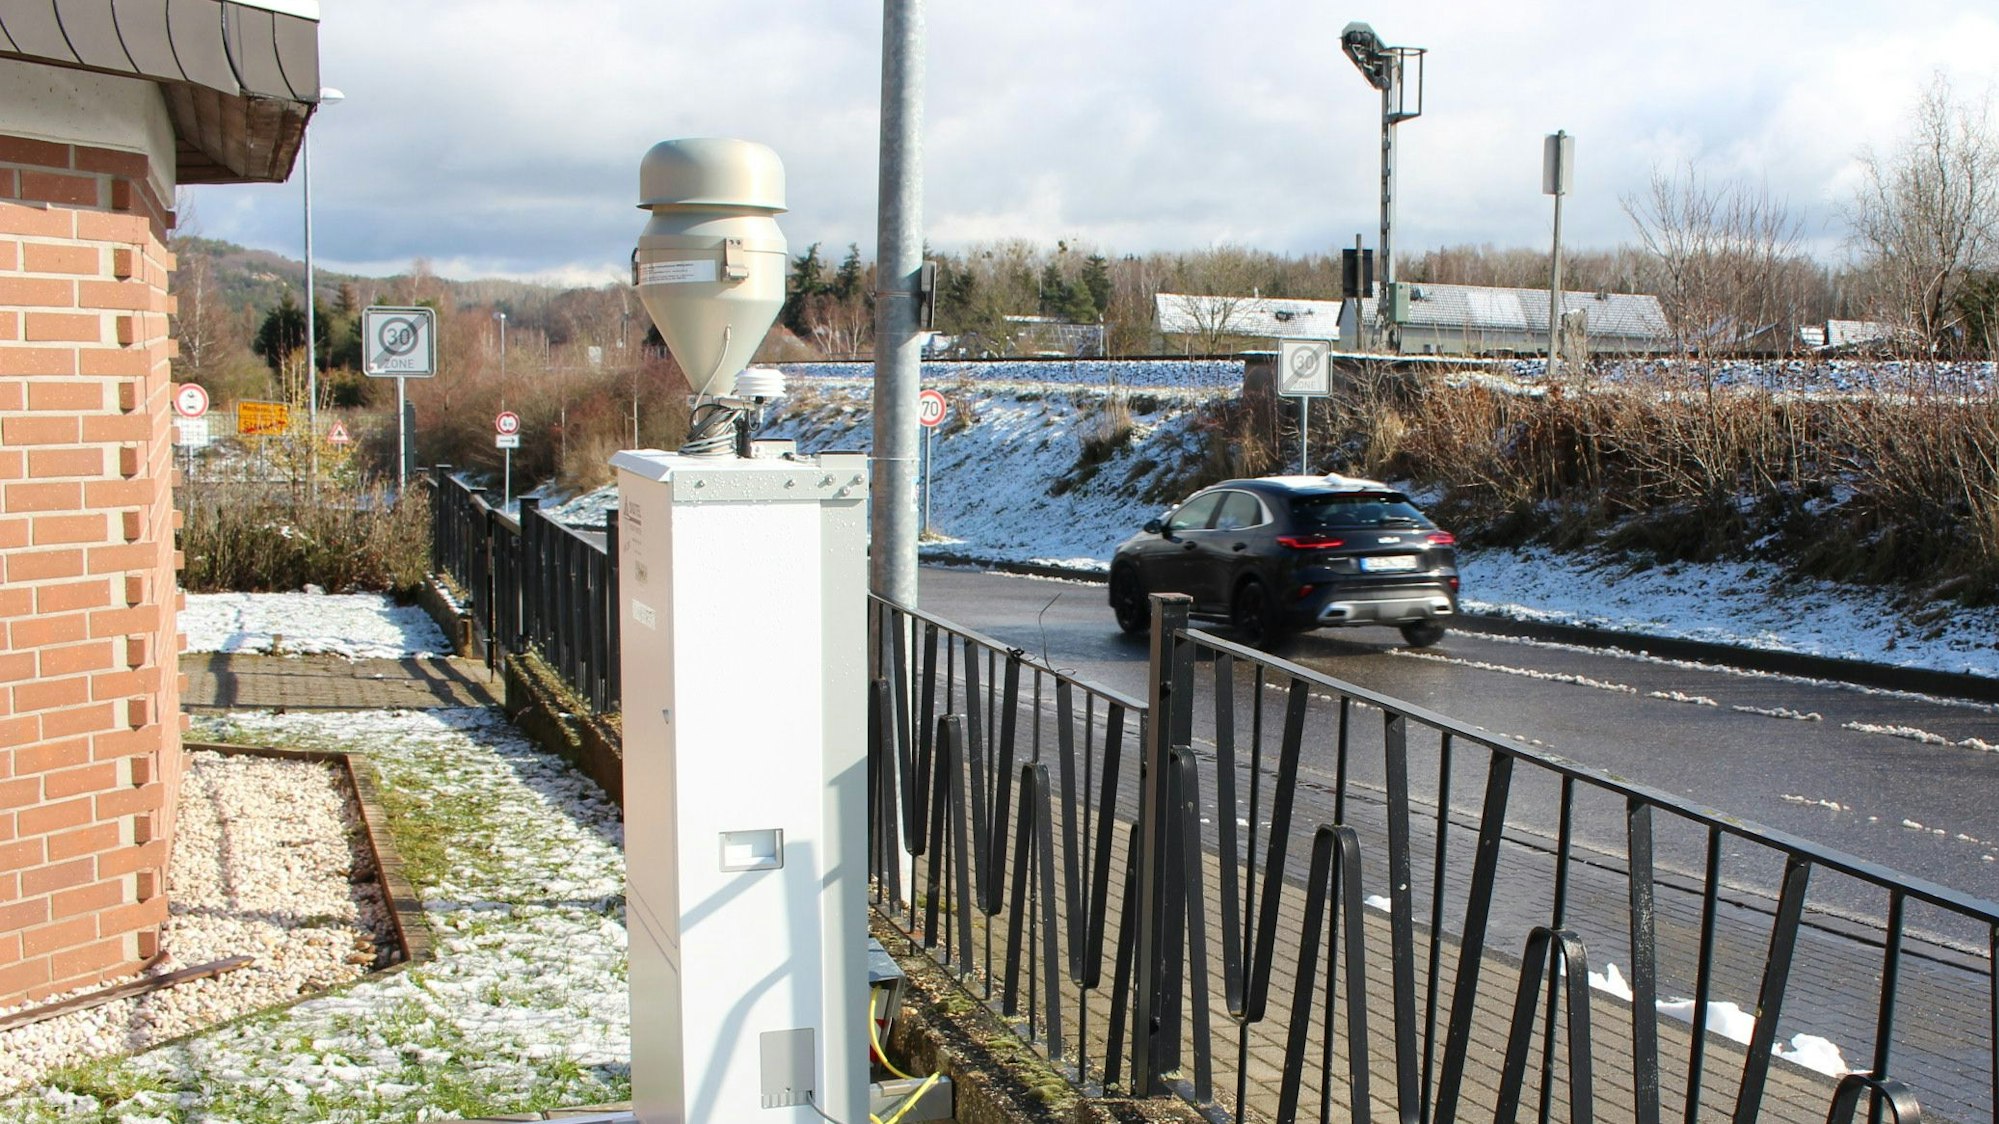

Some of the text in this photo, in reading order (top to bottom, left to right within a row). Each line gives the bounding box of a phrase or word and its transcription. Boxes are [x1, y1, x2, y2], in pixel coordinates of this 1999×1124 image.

[386, 328, 410, 345] 30
[384, 359, 415, 369] ZONE
[1296, 354, 1314, 370] 30
[922, 401, 939, 416] 70
